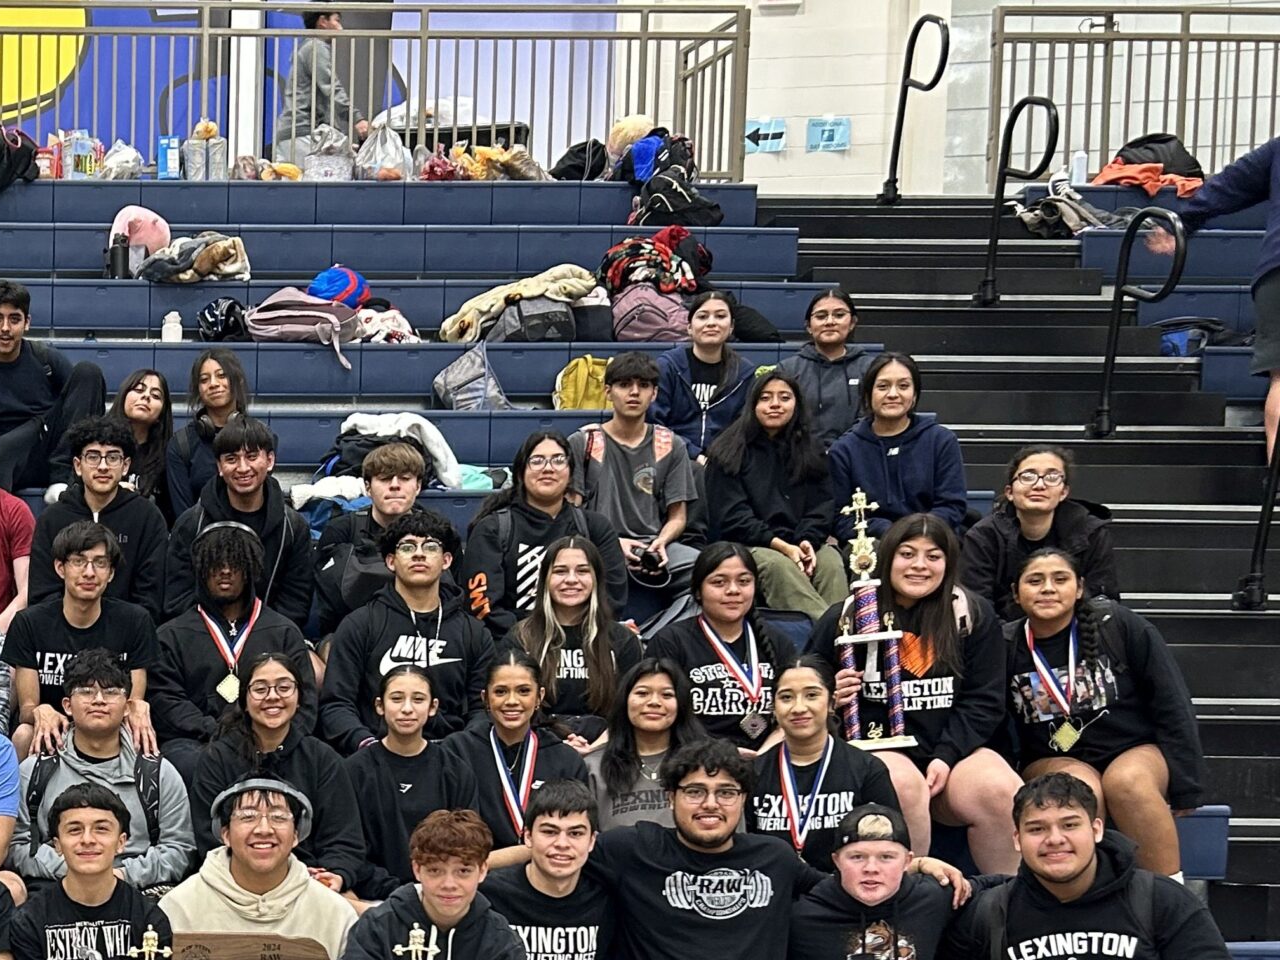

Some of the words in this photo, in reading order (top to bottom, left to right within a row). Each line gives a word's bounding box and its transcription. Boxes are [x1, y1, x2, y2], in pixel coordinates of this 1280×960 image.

[391, 635, 447, 664] NIKE
[697, 878, 743, 895] RAW
[262, 943, 281, 951] 2024
